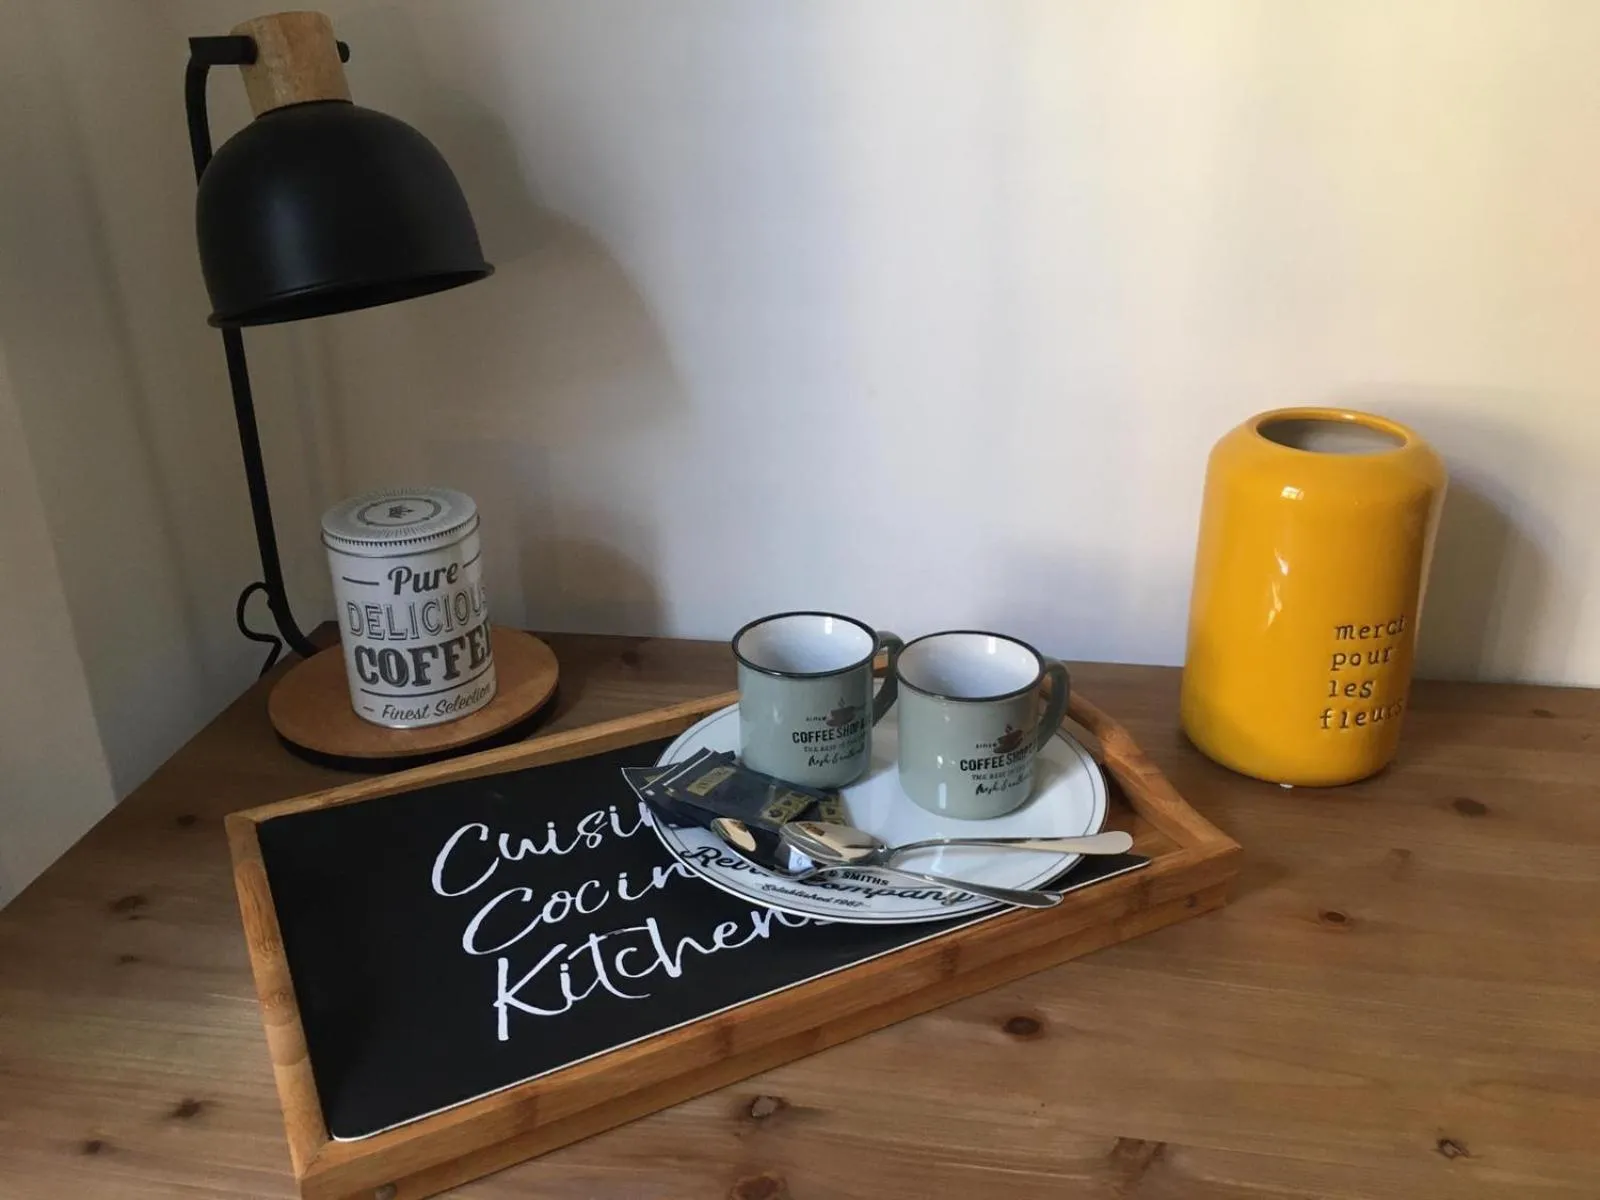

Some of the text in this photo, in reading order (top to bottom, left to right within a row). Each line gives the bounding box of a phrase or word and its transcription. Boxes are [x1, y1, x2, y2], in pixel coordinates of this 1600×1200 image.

[388, 562, 459, 596] Pure
[347, 585, 487, 641] DELICIOU
[1334, 615, 1405, 640] merci
[1330, 646, 1393, 672] pour
[382, 683, 491, 721] Finest Selection
[1328, 679, 1374, 699] les
[792, 728, 835, 744] COFFEE
[960, 754, 1005, 772] COFFEE
[431, 801, 658, 897] Cuisi
[841, 870, 889, 886] SMITHS
[462, 861, 702, 956] Cocin
